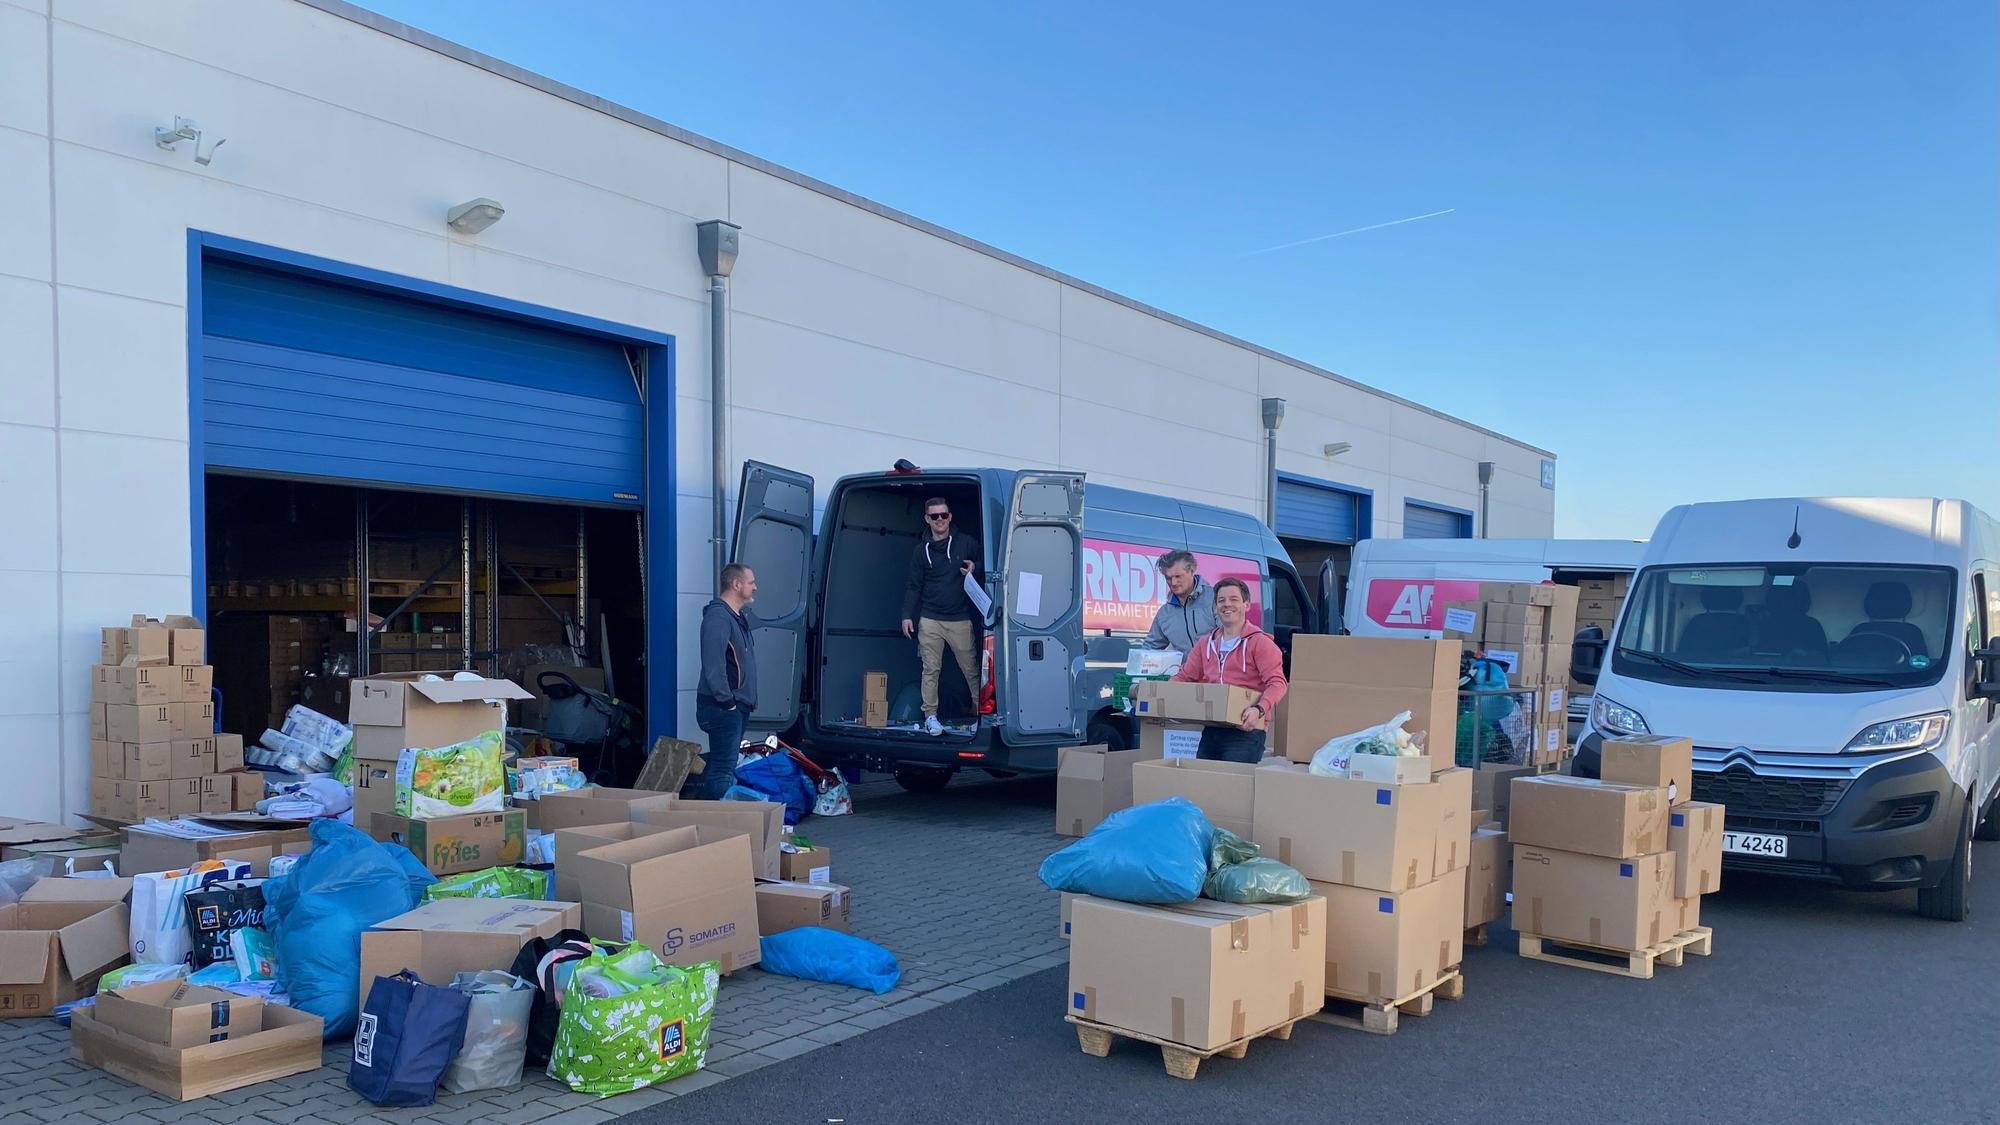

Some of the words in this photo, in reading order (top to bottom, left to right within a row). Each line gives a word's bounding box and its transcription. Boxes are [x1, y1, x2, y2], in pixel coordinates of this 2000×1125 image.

[1741, 836, 1784, 854] 4248
[689, 922, 736, 943] SOMATER
[664, 1038, 681, 1052] ALDI
